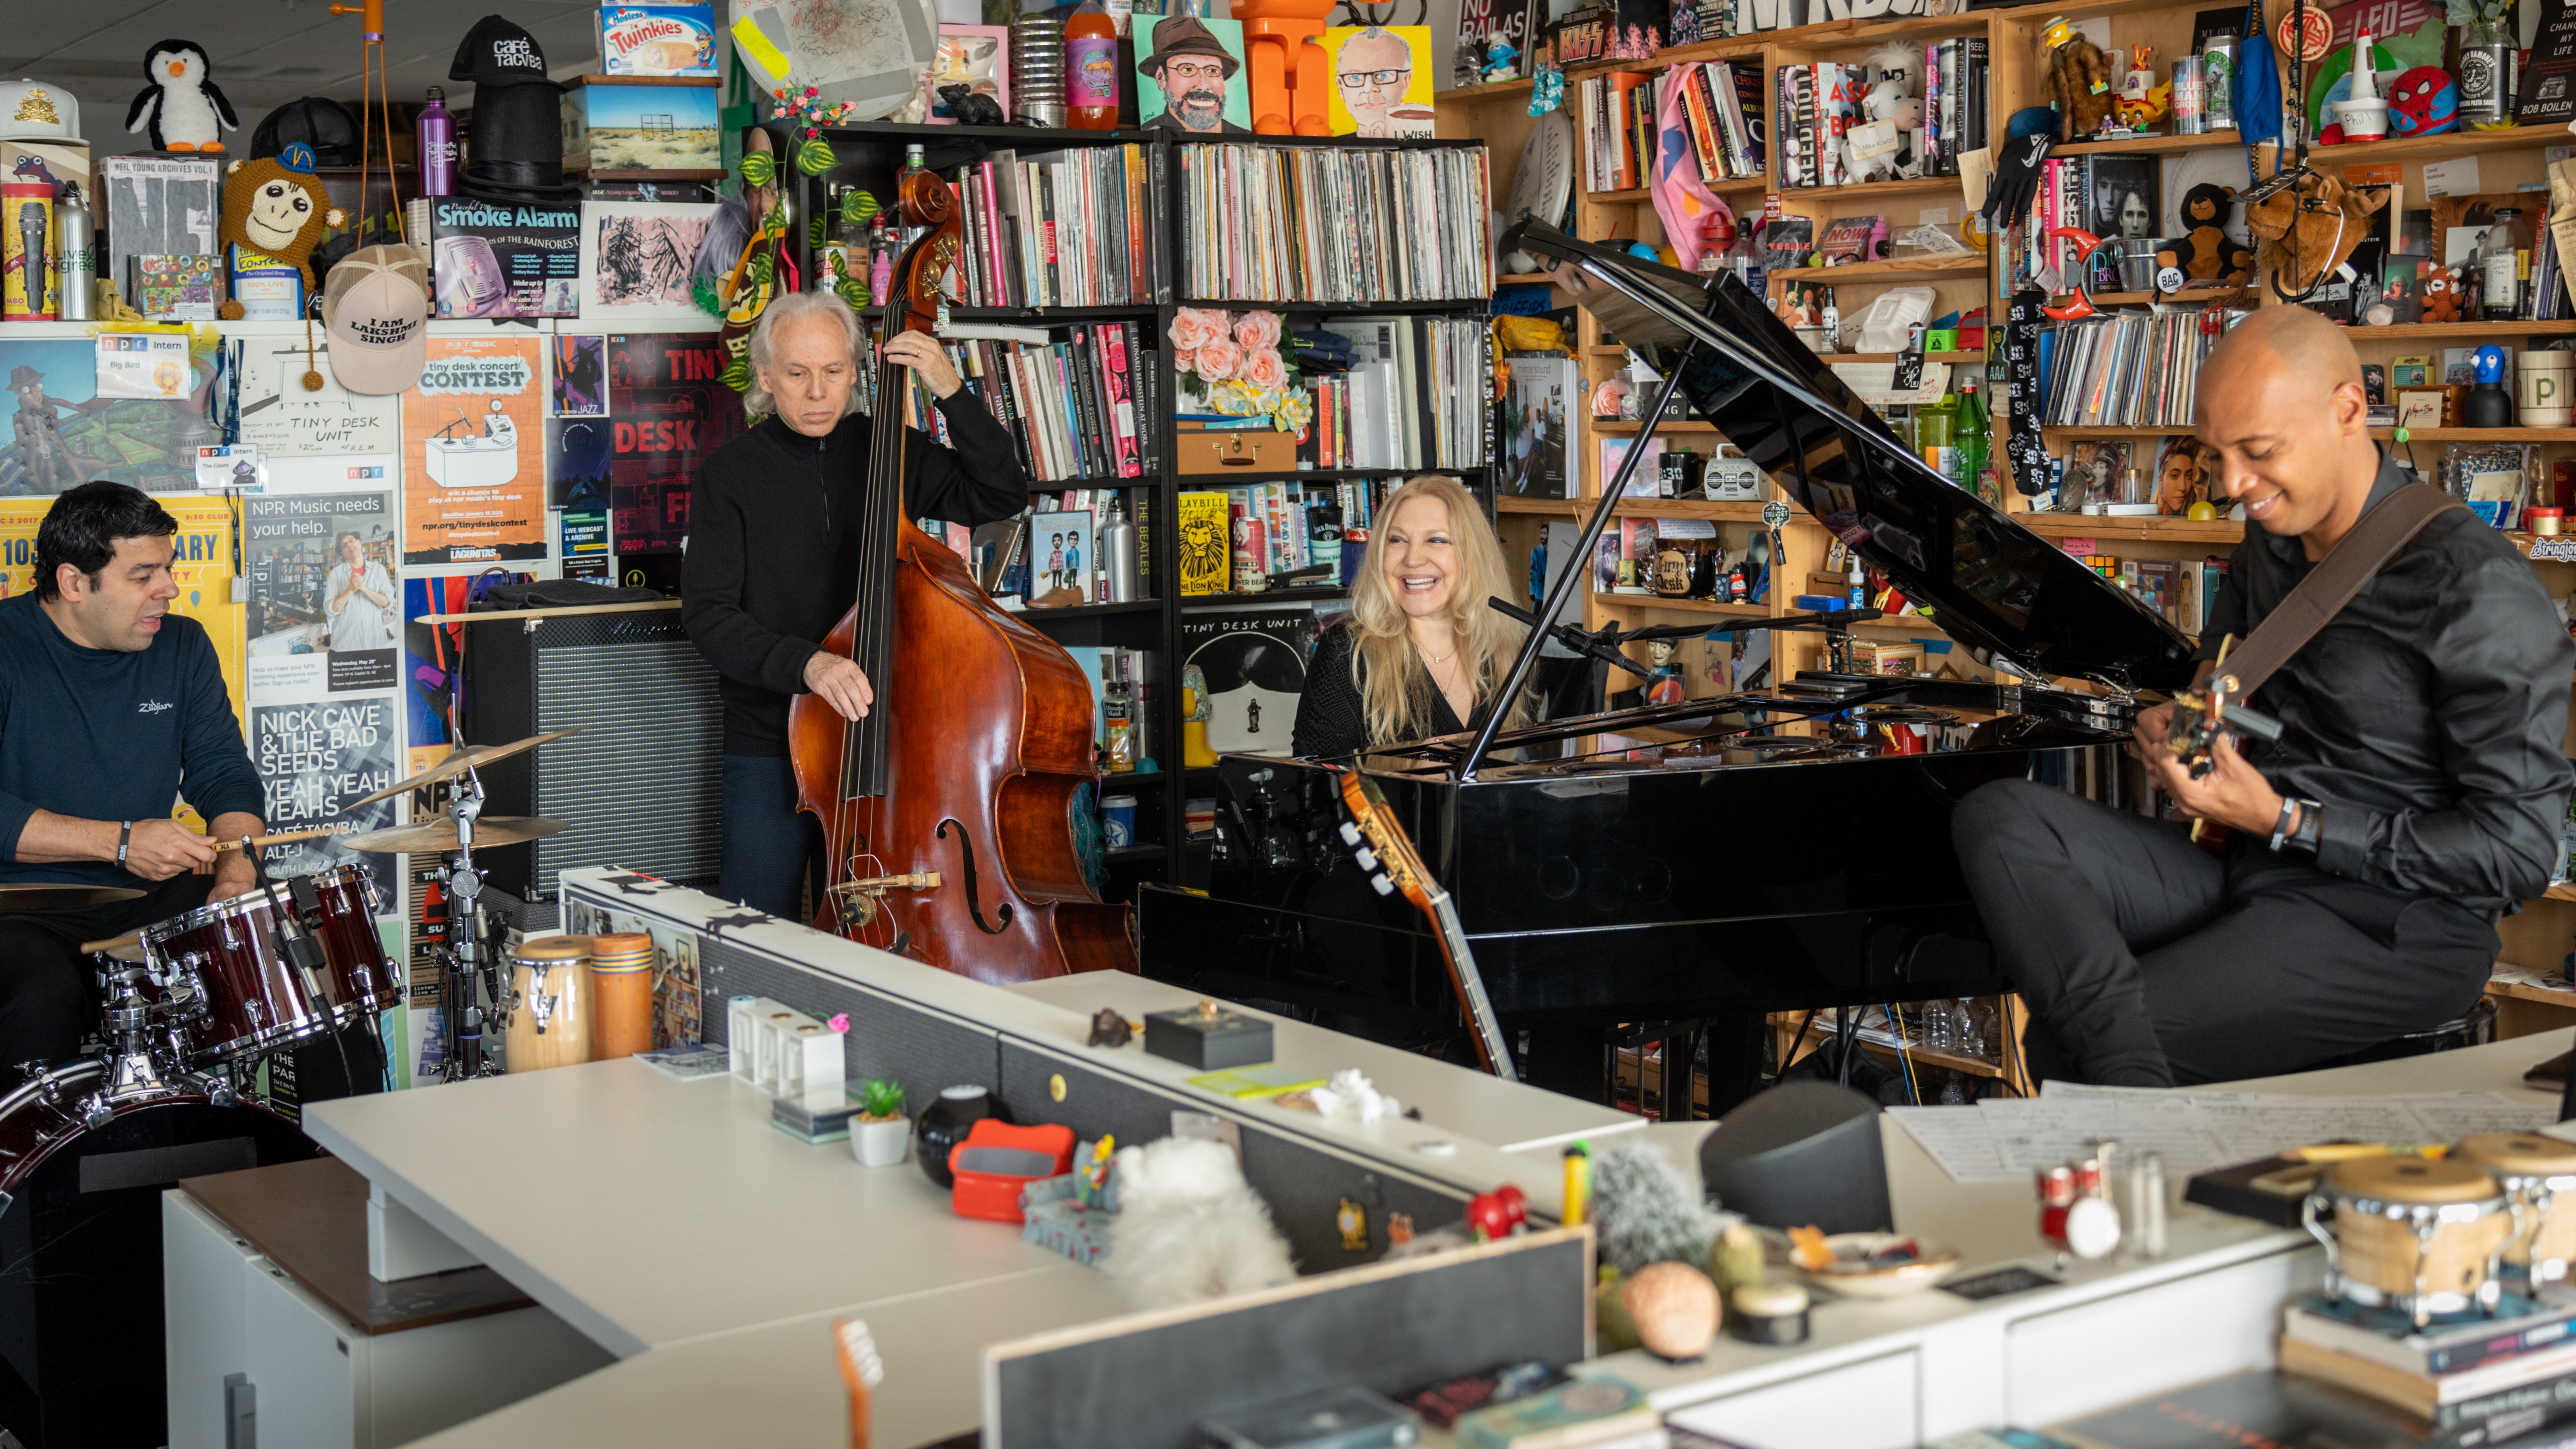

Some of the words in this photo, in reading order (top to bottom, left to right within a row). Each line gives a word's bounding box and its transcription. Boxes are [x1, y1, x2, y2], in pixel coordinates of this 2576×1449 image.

[1696, 4, 1717, 13] MASTER
[613, 12, 644, 24] Hostess
[610, 22, 682, 55] Twinkies
[2202, 29, 2212, 38] MY
[2215, 26, 2238, 36] OWN
[2560, 33, 2573, 43] MY
[1559, 21, 1603, 63] KISS
[2553, 46, 2573, 56] LIFE
[1091, 79, 1109, 87] Soda
[2175, 81, 2203, 91] BLUE
[1829, 83, 1872, 102] ASK
[2175, 91, 2203, 101] MAN
[1680, 100, 1688, 119] JAGGER
[2522, 105, 2539, 115] BOB
[2540, 101, 2573, 113] BOILEN
[1403, 130, 1432, 139] WISH
[1862, 143, 1876, 152] Mike
[115, 162, 130, 170] NEIL
[132, 164, 155, 172] YOUNG
[158, 164, 191, 174] ARCHIVES
[451, 200, 479, 211] Peaceful
[438, 203, 512, 226] Smoke
[515, 206, 578, 227] Alarm
[1828, 228, 1867, 241] NOW
[2557, 225, 2570, 233] NPR
[524, 235, 579, 250] RAINFOREST
[981, 228, 989, 252] WILLIAMS
[1768, 242, 1811, 251] YESSIE
[2161, 272, 2178, 287] BAC
[351, 319, 418, 336] LAKSHMI
[371, 318, 375, 326] I
[381, 318, 404, 327] AM
[105, 338, 145, 350] npr
[154, 341, 181, 350] Intern
[361, 334, 406, 344] SINGH
[111, 361, 122, 370] Big
[429, 363, 449, 371] tiny
[452, 363, 477, 371] desk
[479, 362, 518, 371] concert
[666, 350, 725, 380] TINY
[1534, 365, 1550, 374] sound
[420, 371, 525, 388] CONTEST
[1132, 337, 1140, 372] LEONARD
[1140, 414, 1146, 422] AT
[1989, 366, 2005, 381] AAA
[1021, 386, 1029, 410] kansas
[578, 405, 598, 414] JAZZ
[1083, 375, 1092, 404] ROLLING
[1088, 406, 1097, 435] STONES
[1093, 436, 1099, 445] 50
[291, 418, 331, 428] TINY
[342, 417, 379, 428] DESK
[316, 431, 352, 441] UNIT
[614, 420, 697, 453] DESK
[202, 448, 228, 457] npr
[349, 468, 382, 479] npr
[253, 502, 284, 515] NPR
[290, 500, 331, 514] Music
[336, 497, 379, 512] needs
[1138, 500, 1148, 524] THE
[253, 524, 286, 538] your
[292, 520, 327, 536] help.
[422, 519, 527, 530] npr.org/tinydeskcontest
[1281, 528, 1289, 541] 40
[451, 548, 496, 558] LAGUNITAS
[1139, 527, 1149, 575] BEATLES
[1283, 542, 1292, 570] ALBUMS
[1184, 623, 1214, 633] TINY
[1223, 621, 1260, 630] DESK
[1267, 619, 1302, 629] UNIT
[138, 699, 173, 714] Zildjian
[261, 710, 317, 734] NICK
[323, 705, 381, 729] CAVE
[331, 726, 377, 749] BAD
[262, 750, 338, 776] SEEDS
[263, 776, 323, 801] YEAH
[329, 770, 389, 795] YEAH
[265, 796, 339, 822] YEAHS
[265, 844, 303, 860] ALT-J
[266, 865, 296, 876] YOUTH
